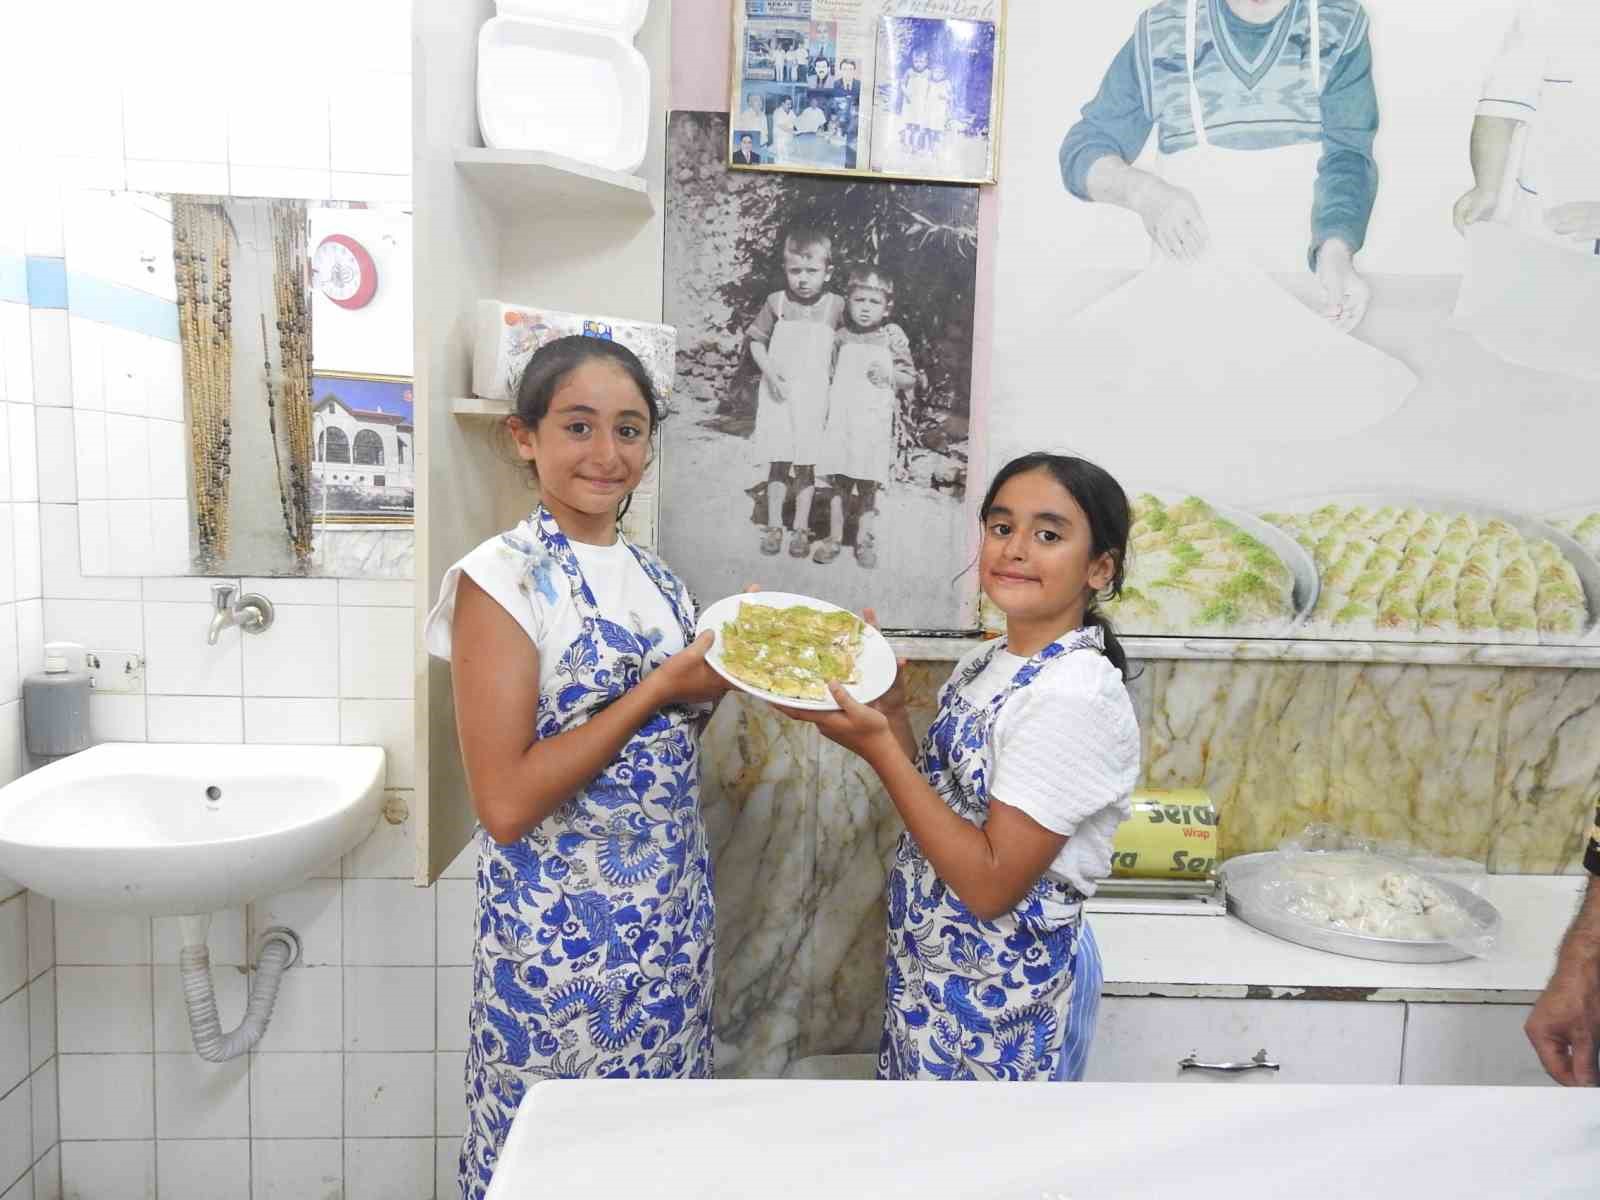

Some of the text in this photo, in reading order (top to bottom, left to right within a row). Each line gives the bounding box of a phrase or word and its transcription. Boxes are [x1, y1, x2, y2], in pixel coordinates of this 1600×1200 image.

[1147, 800, 1218, 826] Sera
[1182, 827, 1210, 840] Wrap
[1110, 850, 1216, 873] ra Ser
